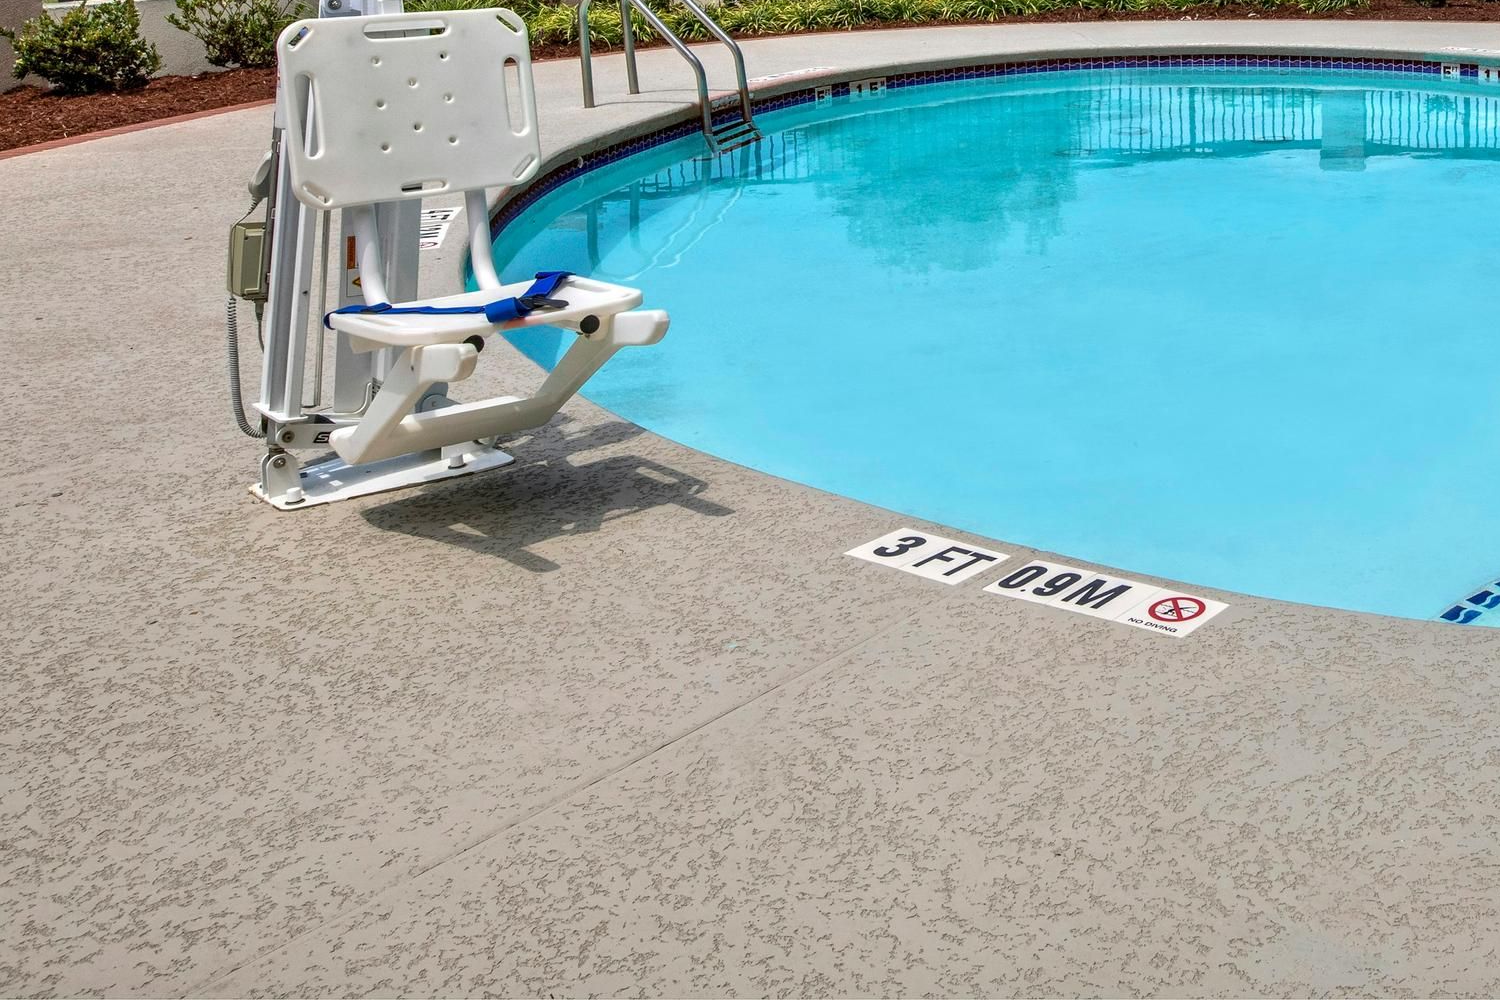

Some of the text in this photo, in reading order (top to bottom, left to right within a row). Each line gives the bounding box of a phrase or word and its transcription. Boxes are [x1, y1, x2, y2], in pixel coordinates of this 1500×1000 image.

[873, 536, 998, 576] 3 FT
[1144, 621, 1178, 633] DIVING
